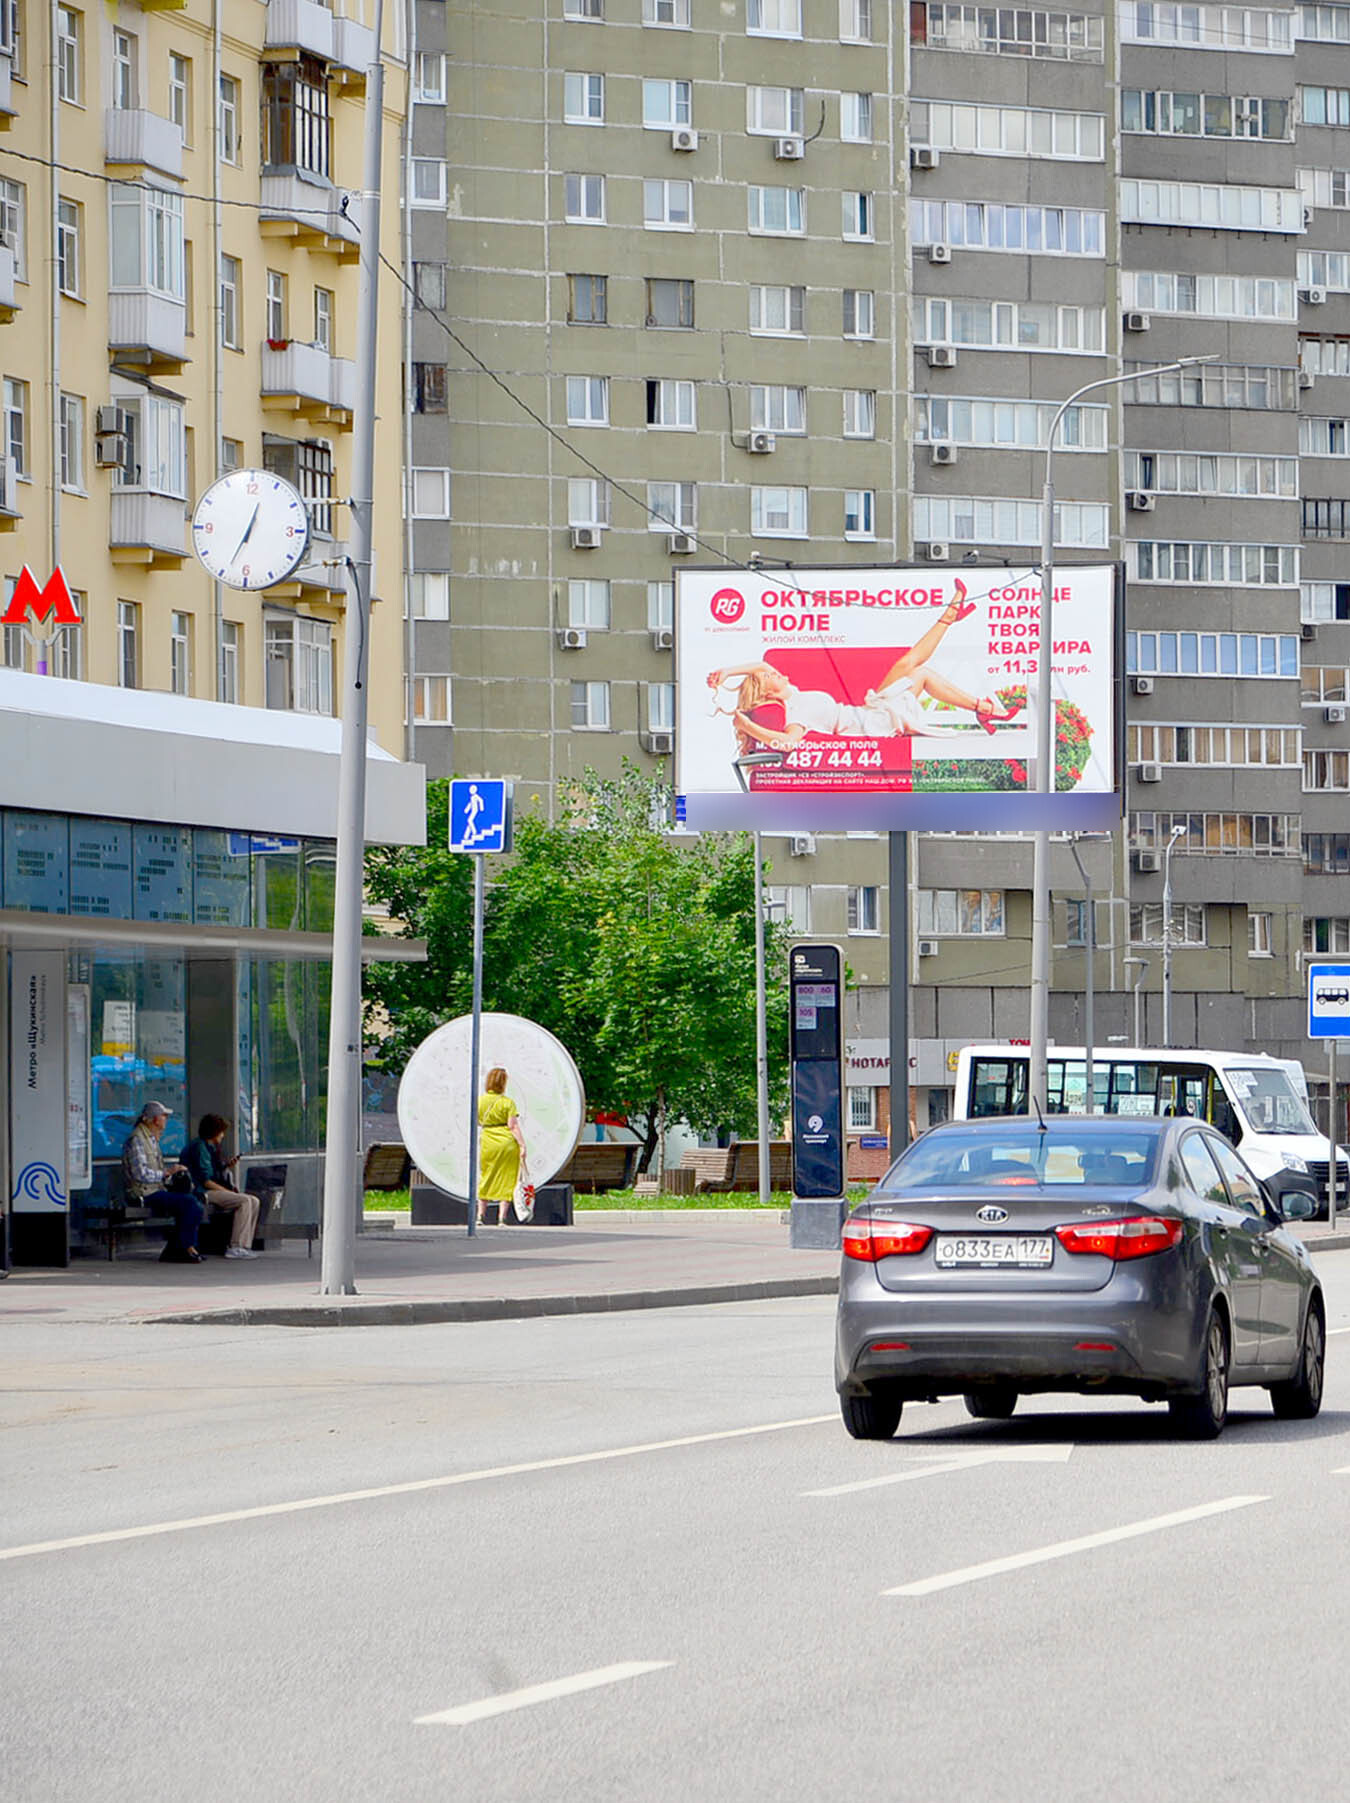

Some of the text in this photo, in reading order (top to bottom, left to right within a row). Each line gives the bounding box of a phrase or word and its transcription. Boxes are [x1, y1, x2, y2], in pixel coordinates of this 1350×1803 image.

[247, 484, 258, 495] 12
[205, 523, 213, 533] 9
[286, 526, 294, 537] 3
[242, 565, 250, 576] 6
[761, 588, 943, 608] ОКТЯБРЬСКОЕ
[988, 605, 1041, 619] ПАРК
[761, 614, 830, 631] ПОЛЕ
[988, 623, 1040, 637] ТВОЯ
[761, 635, 846, 644] ЖИЛОЙ КОМПЛЕКС
[988, 641, 1092, 654] КВАРИРА
[1003, 660, 1038, 676] 11,3
[1067, 664, 1091, 675] руб.
[770, 739, 847, 751] Октябрьское
[849, 740, 879, 750] поле
[786, 751, 824, 768] 487
[827, 750, 853, 767] 44
[857, 750, 883, 767] 44
[852, 1057, 917, 1068] НОТАРС
[27, 1051, 37, 1089] Метро
[981, 1209, 1004, 1221] KIA
[1019, 1239, 1047, 1254] 177
